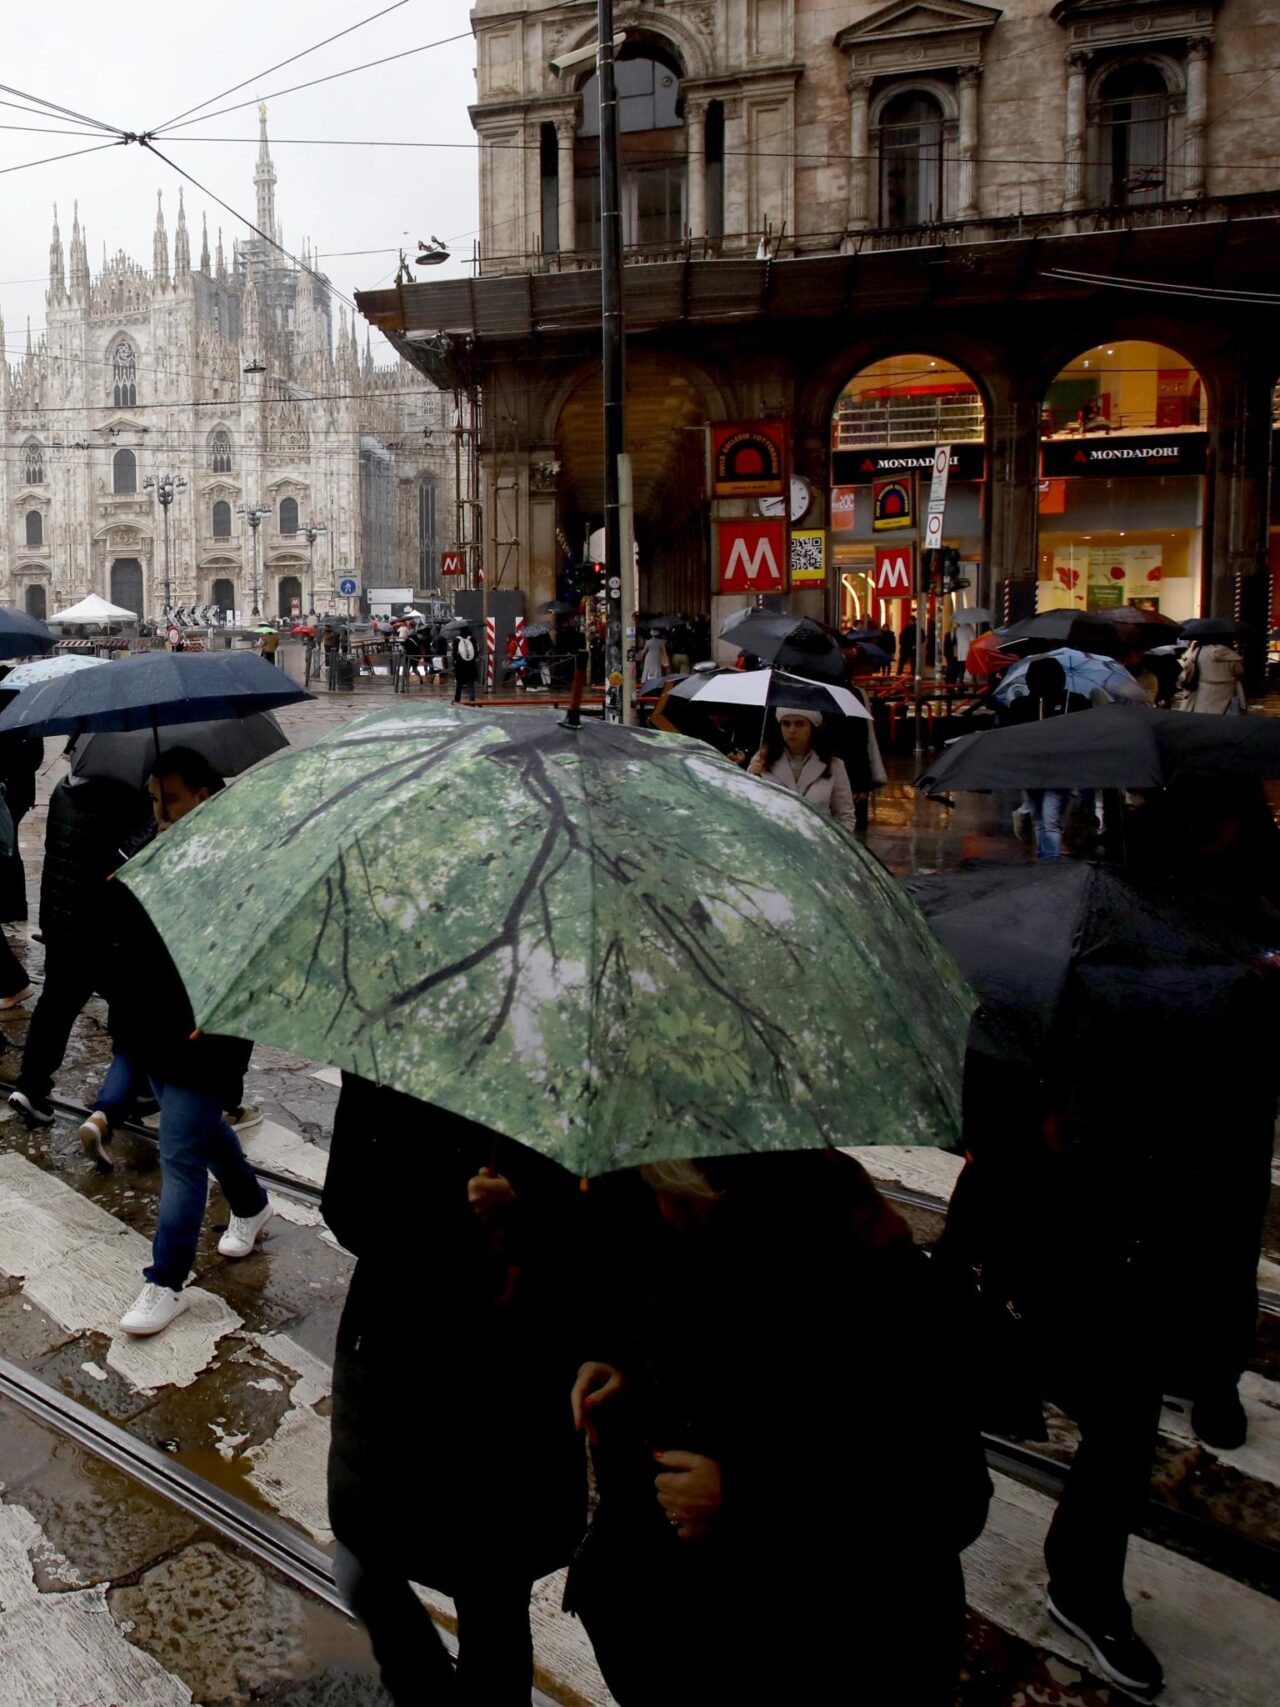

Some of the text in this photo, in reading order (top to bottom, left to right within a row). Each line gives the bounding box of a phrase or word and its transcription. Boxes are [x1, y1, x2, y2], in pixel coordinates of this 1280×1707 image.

[877, 456, 959, 469] MONDADI
[1089, 447, 1179, 460] MONDADORI
[724, 537, 781, 580] M
[877, 557, 910, 589] M
